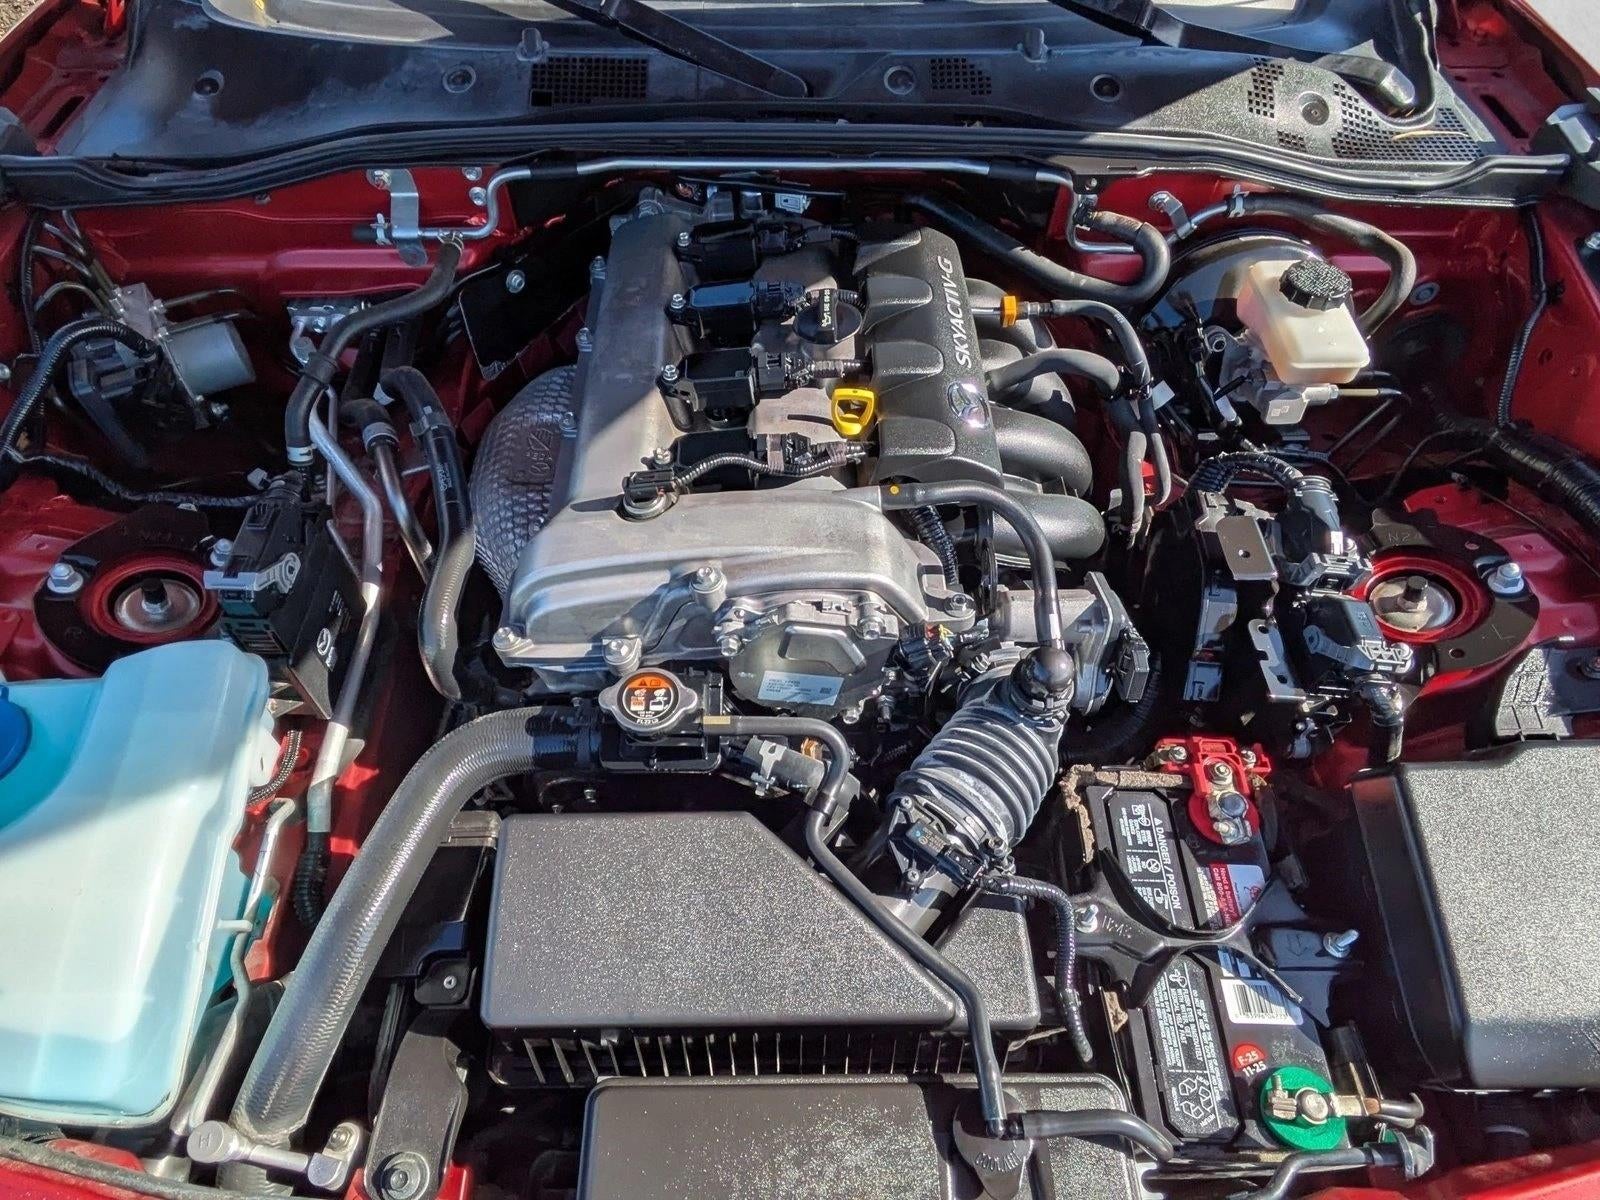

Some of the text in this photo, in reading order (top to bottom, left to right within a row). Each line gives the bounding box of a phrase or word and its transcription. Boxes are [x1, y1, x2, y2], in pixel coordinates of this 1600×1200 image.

[938, 256, 972, 368] SKYACTIV-G
[1155, 827, 1170, 864] DANGER
[1165, 873, 1180, 909] POISON
[1212, 867, 1220, 880] Call
[1219, 867, 1229, 884] Need
[1242, 1060, 1267, 1078] 11-25
